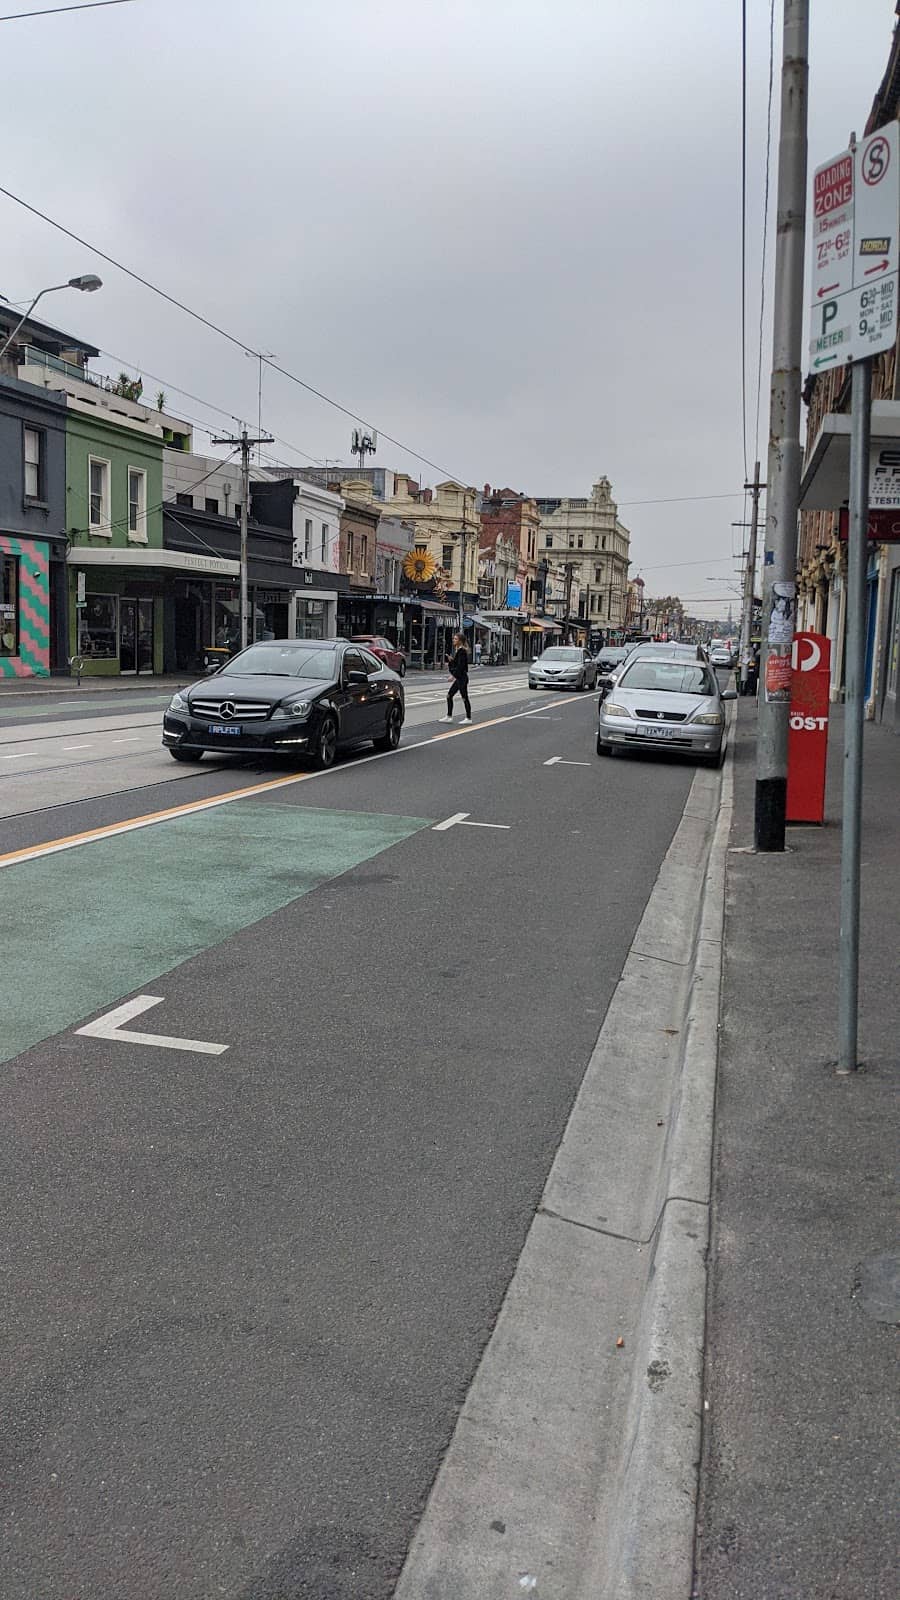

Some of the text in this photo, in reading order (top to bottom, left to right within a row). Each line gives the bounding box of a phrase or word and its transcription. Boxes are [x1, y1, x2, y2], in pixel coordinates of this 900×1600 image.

[815, 159, 851, 193] LOADING
[815, 181, 852, 216] ZONE
[822, 301, 838, 335] P
[816, 330, 844, 352] METER
[790, 716, 829, 730] OST
